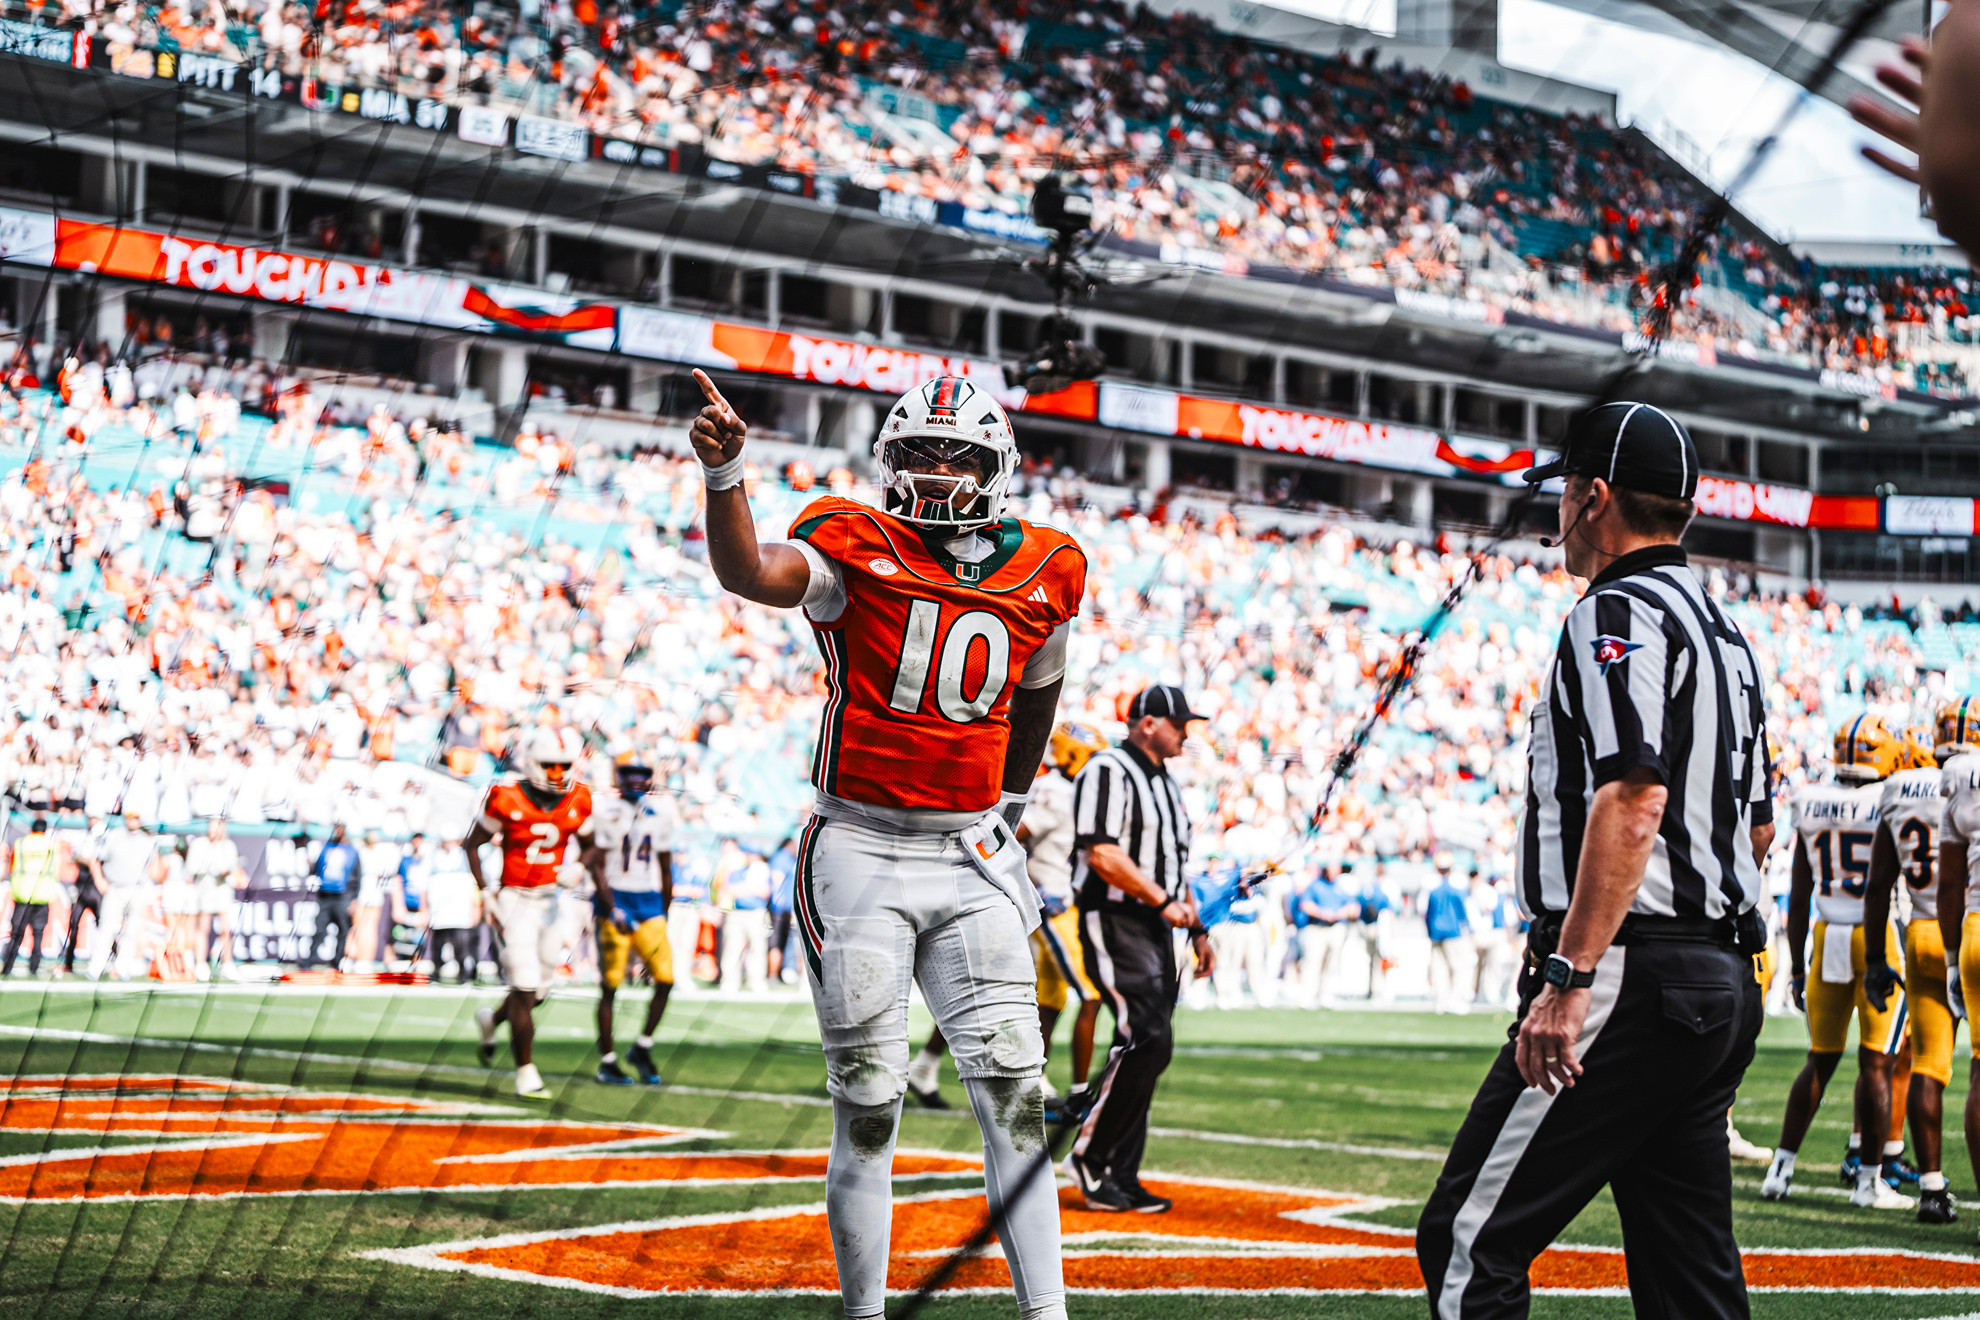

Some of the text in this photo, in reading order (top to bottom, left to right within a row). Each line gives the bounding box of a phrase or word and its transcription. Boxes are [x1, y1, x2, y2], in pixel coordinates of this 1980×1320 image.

[251, 66, 282, 99] 14
[160, 235, 467, 320] TOUCHD
[925, 416, 957, 426] MIAMI
[875, 562, 893, 571] ACC
[955, 563, 980, 581] U
[887, 597, 1010, 724] 10
[1805, 800, 1859, 820] FORNEY
[525, 823, 561, 865] 2
[622, 833, 653, 874] 14
[1813, 829, 1875, 898] 15
[1899, 815, 1939, 891] 3
